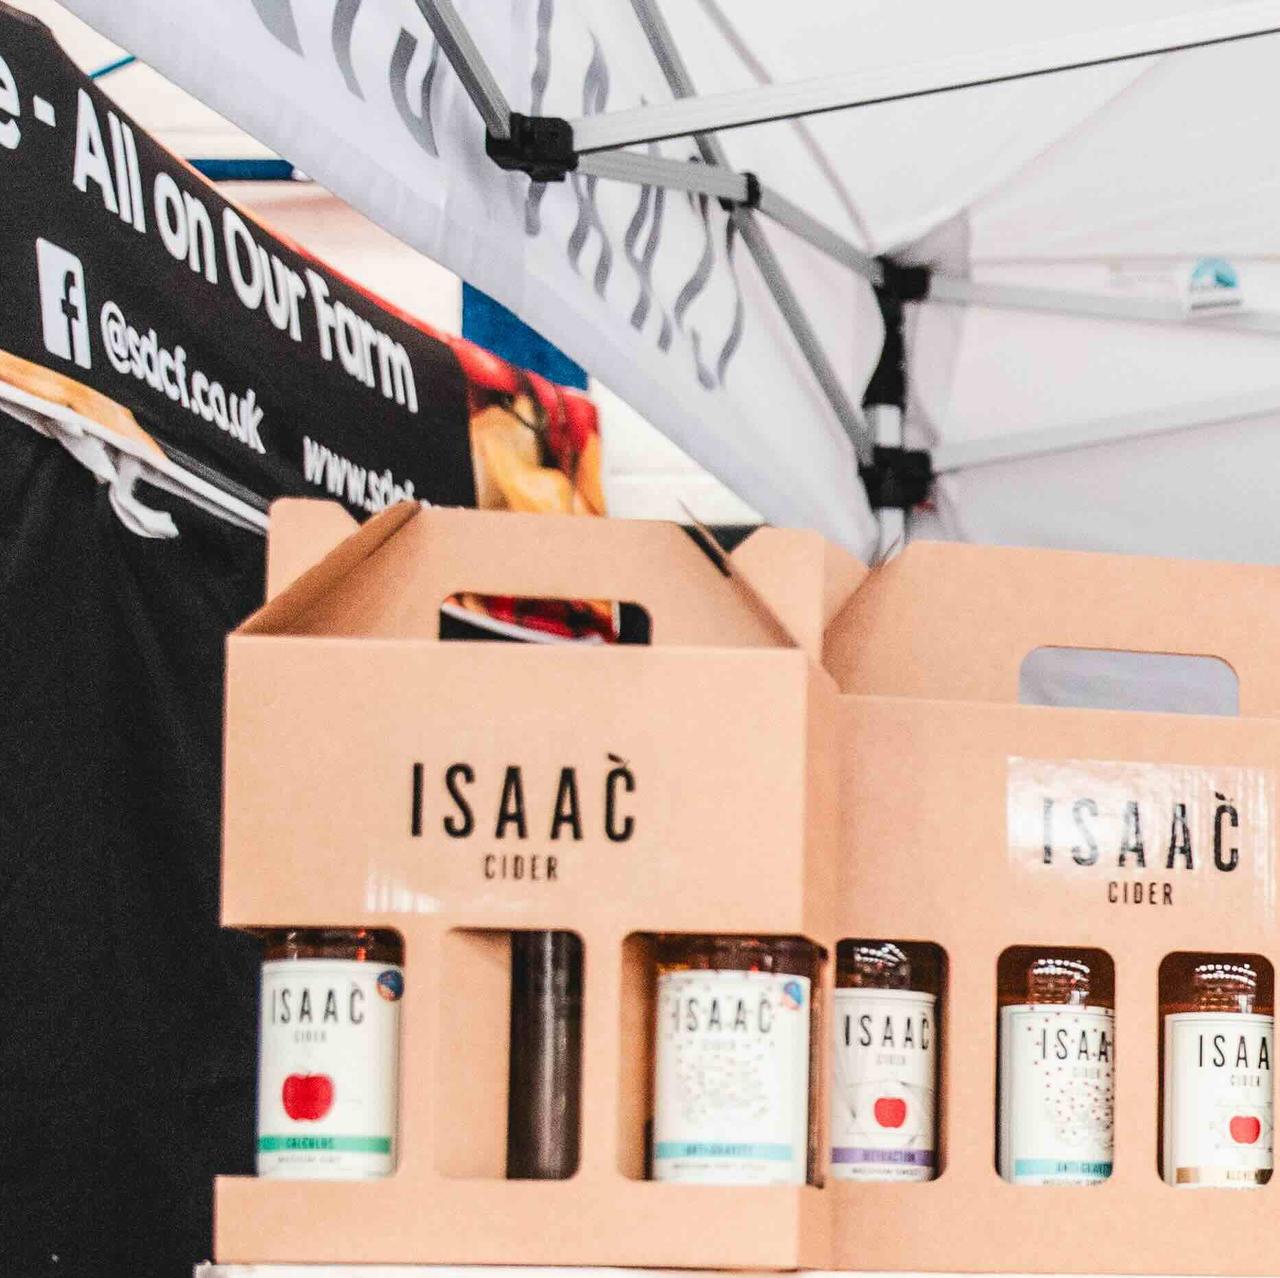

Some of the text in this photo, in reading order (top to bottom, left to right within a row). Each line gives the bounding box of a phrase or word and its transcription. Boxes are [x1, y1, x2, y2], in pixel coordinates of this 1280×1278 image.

[72, 87, 147, 233] All
[153, 171, 219, 284] on
[222, 206, 307, 342] Our
[304, 266, 419, 414] Farm
[100, 300, 268, 455] @sdcf.co.uk
[410, 753, 636, 843] ISAAC
[483, 853, 560, 882] CIDER
[1107, 880, 1174, 906] CIDER
[1041, 1028, 1113, 1063] ISAA
[1199, 1035, 1271, 1070] ISAA
